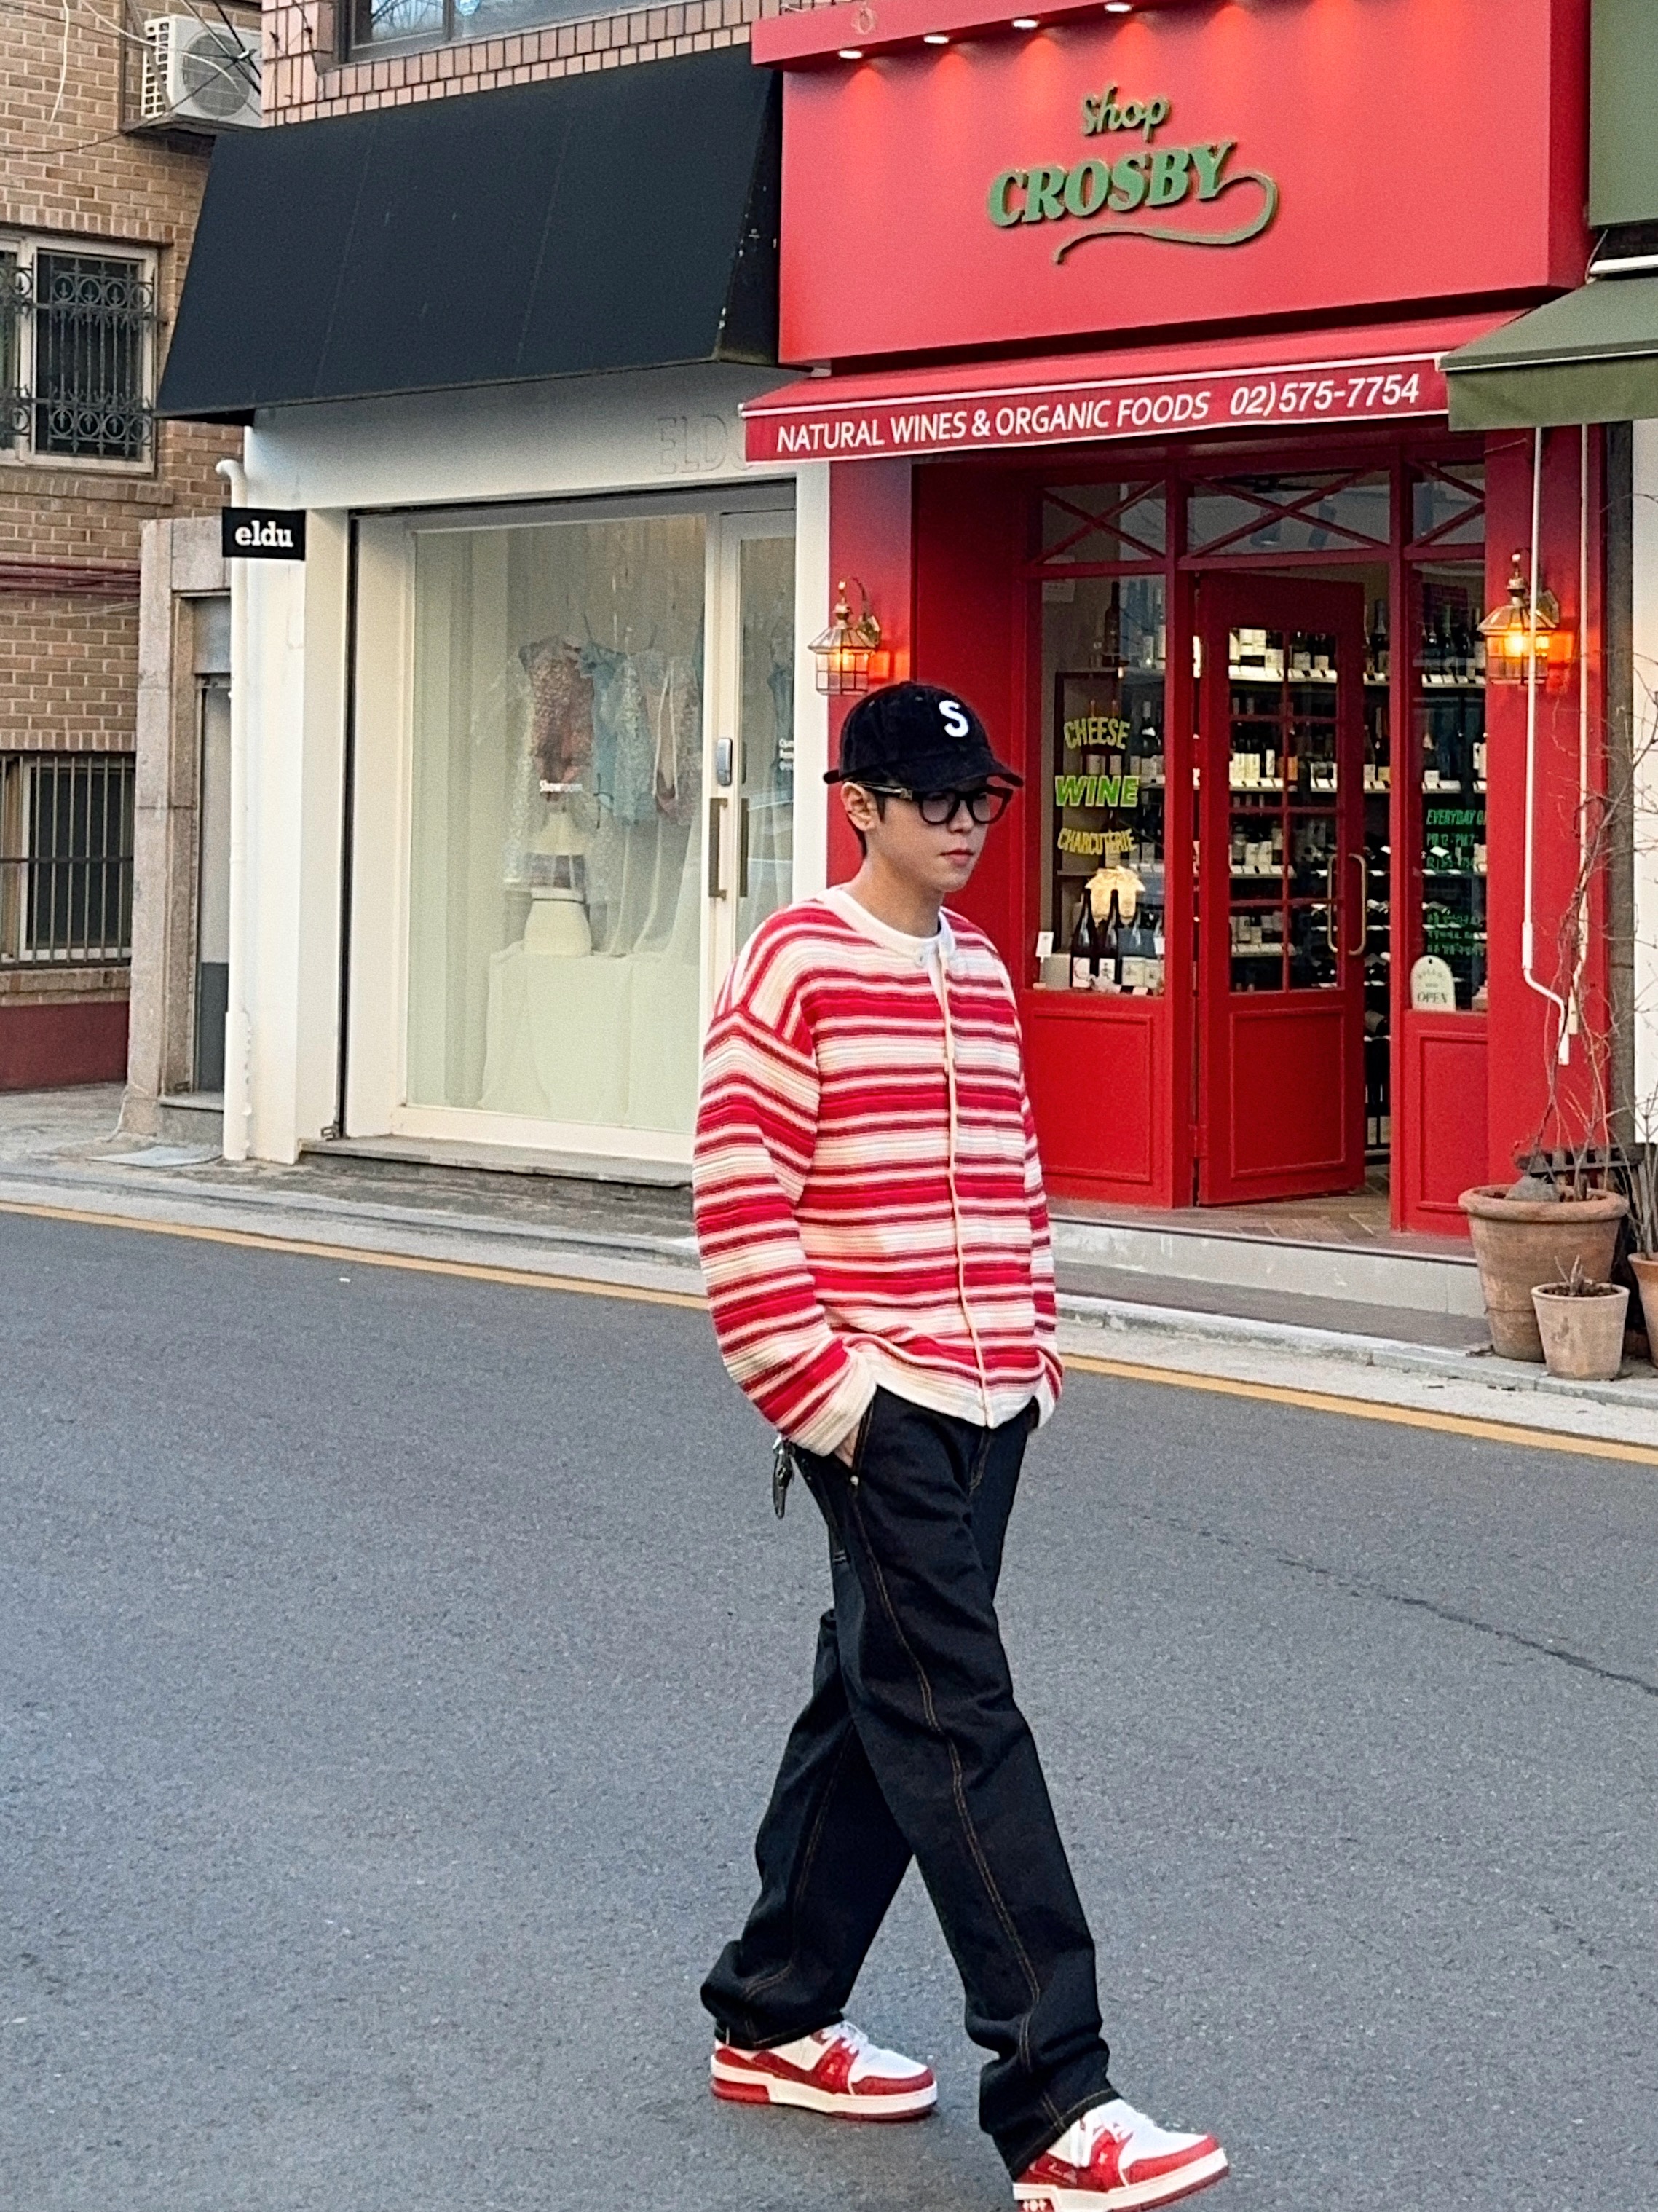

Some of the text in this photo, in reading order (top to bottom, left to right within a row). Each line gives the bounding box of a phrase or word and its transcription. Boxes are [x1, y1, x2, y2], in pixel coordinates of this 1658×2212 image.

[988, 141, 1239, 228] CROSBY
[776, 373, 1419, 452] NATURAL WINES & ORGANIC FOODS 02)575-7754
[234, 519, 294, 548] eldu
[939, 699, 969, 737] S
[1063, 717, 1130, 749] CHEESE
[1055, 775, 1140, 807] WINE
